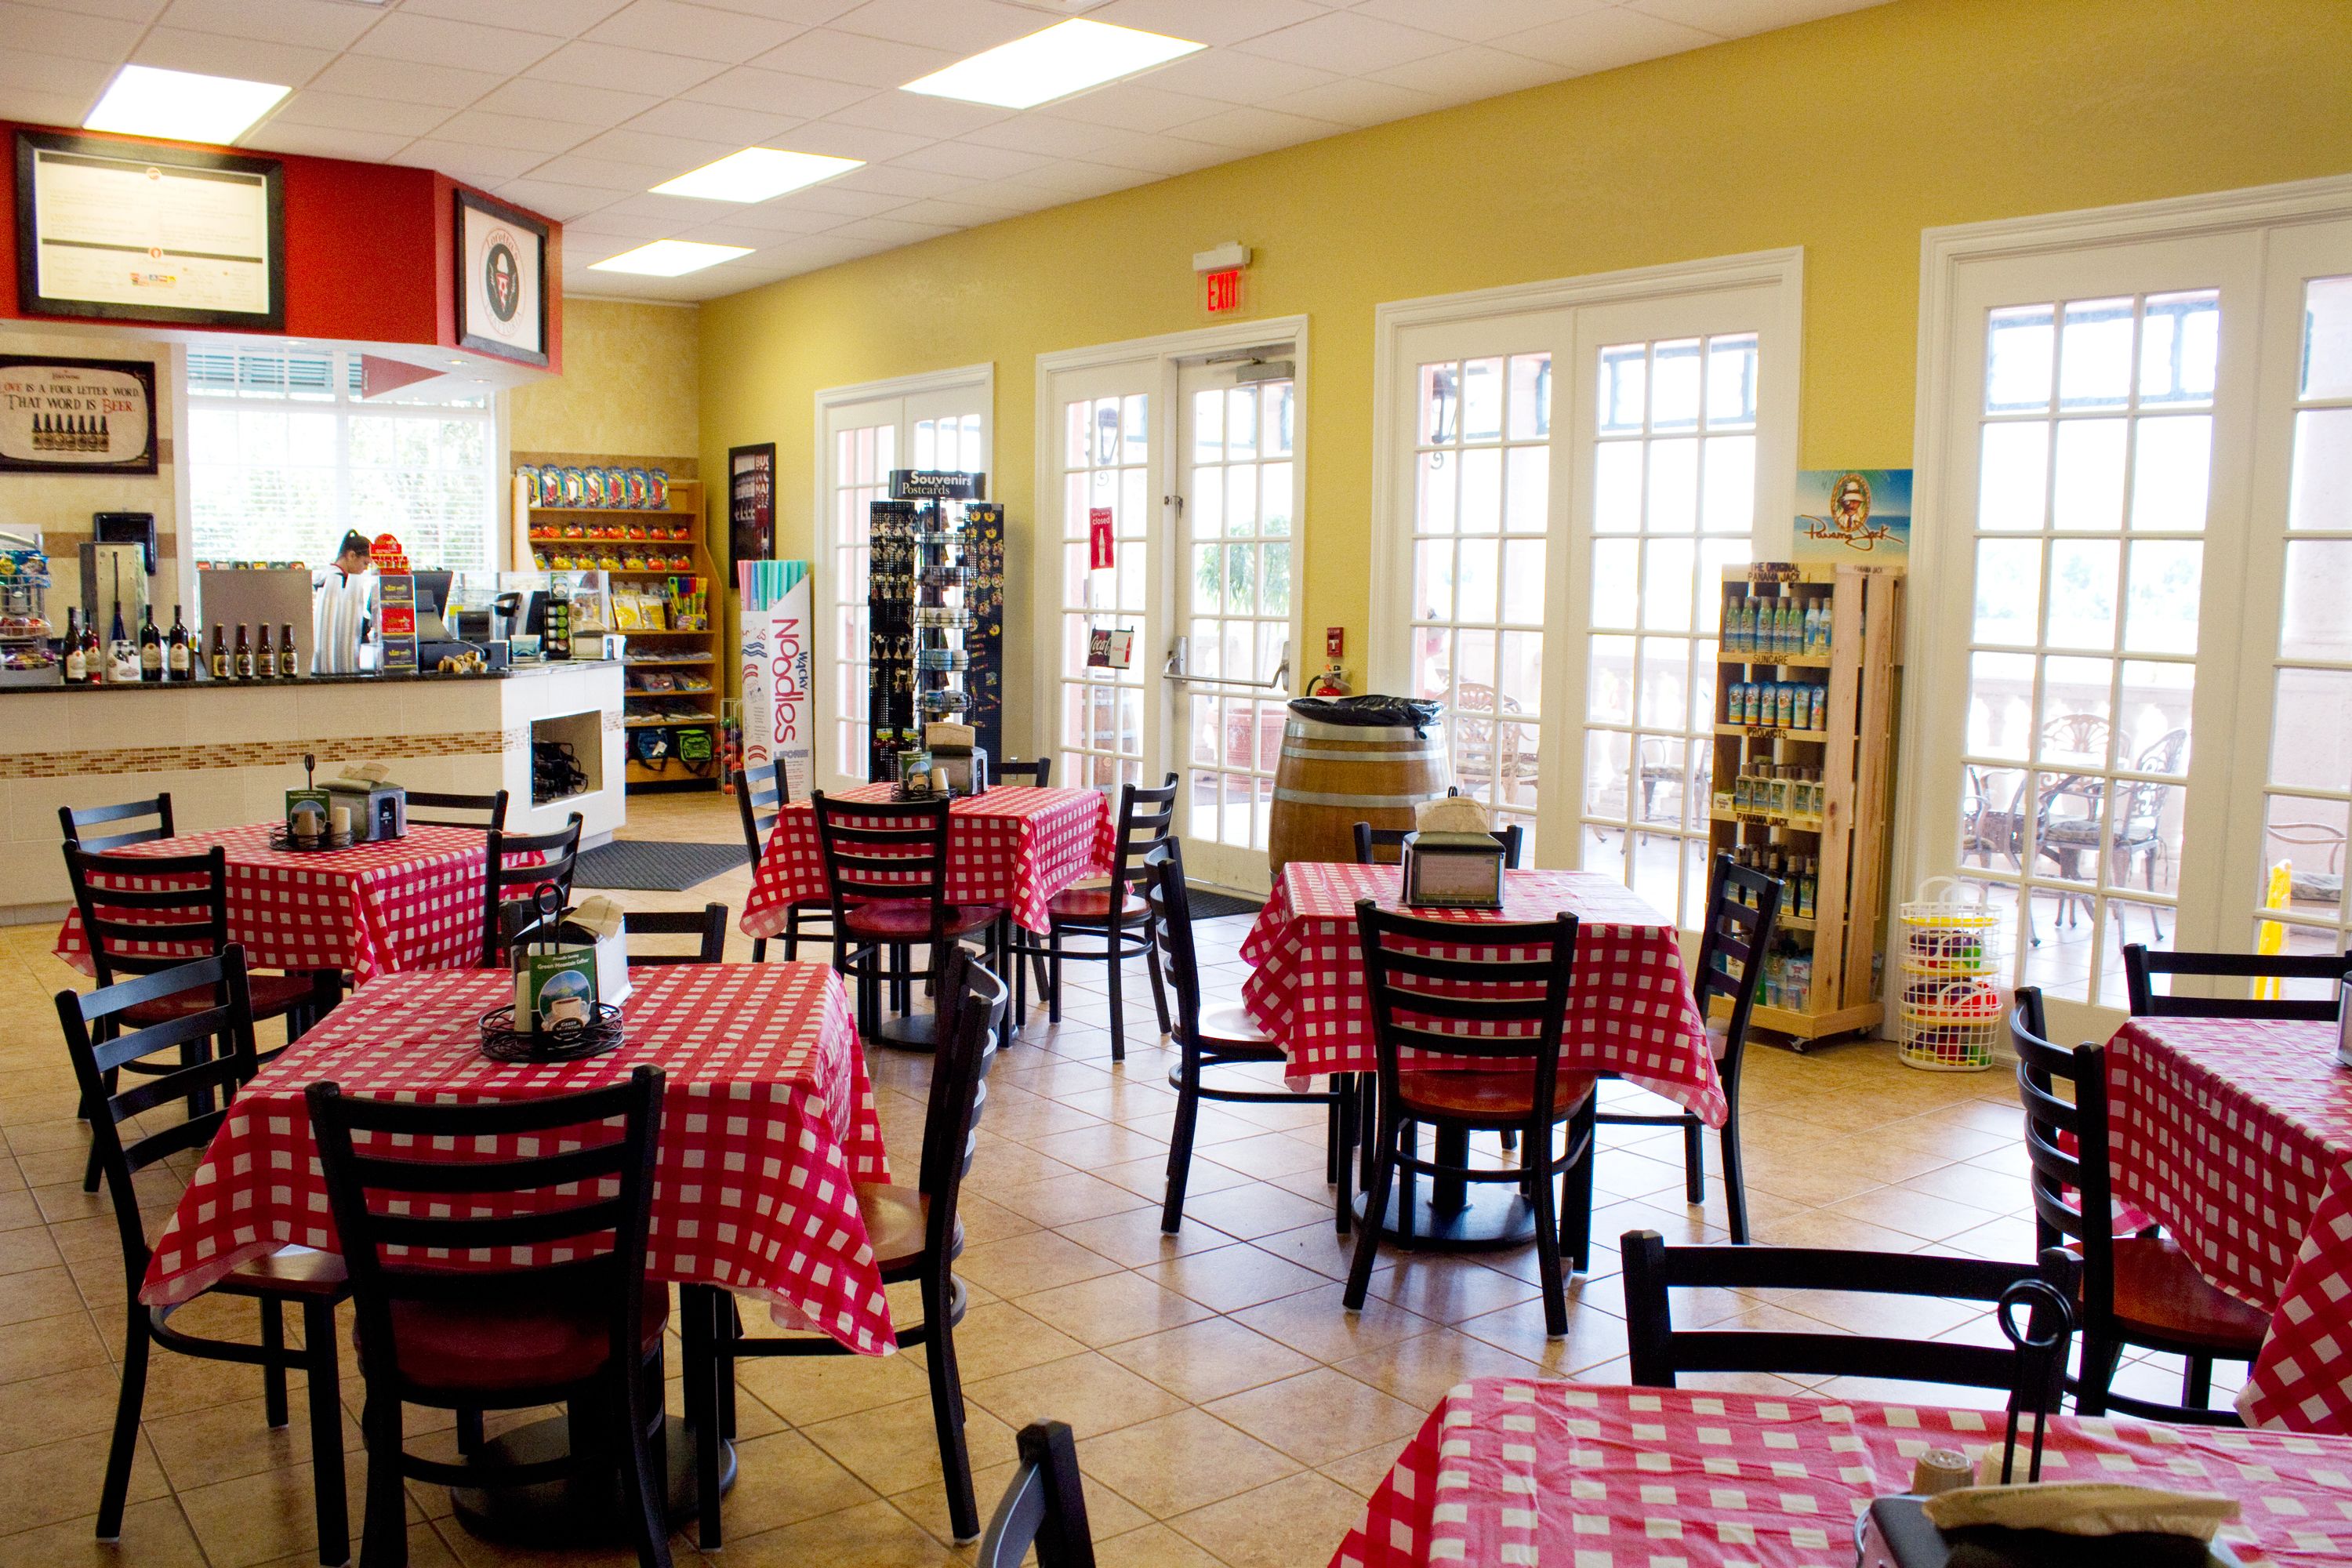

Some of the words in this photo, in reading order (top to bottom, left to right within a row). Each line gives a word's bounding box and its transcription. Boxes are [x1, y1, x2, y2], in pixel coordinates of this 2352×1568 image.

[1207, 270, 1238, 312] EXIT
[2, 383, 22, 391] OVE
[49, 385, 73, 394] FOUR
[77, 387, 108, 396] LETTER
[47, 398, 81, 410] WORD
[86, 400, 96, 410] IS
[910, 470, 971, 486] Souvenirs
[902, 482, 950, 495] Postcards
[1093, 516, 1110, 525] closed
[1751, 562, 1765, 572] THE
[1766, 562, 1799, 573] ORIGINAL
[1748, 572, 1779, 582] PANAMA
[1780, 572, 1801, 583] JACK
[1753, 655, 1788, 665] SUNCARE
[1747, 727, 1788, 739] PRODUCTS
[1737, 812, 1768, 825] PANAMA
[1769, 816, 1789, 828] JACK
